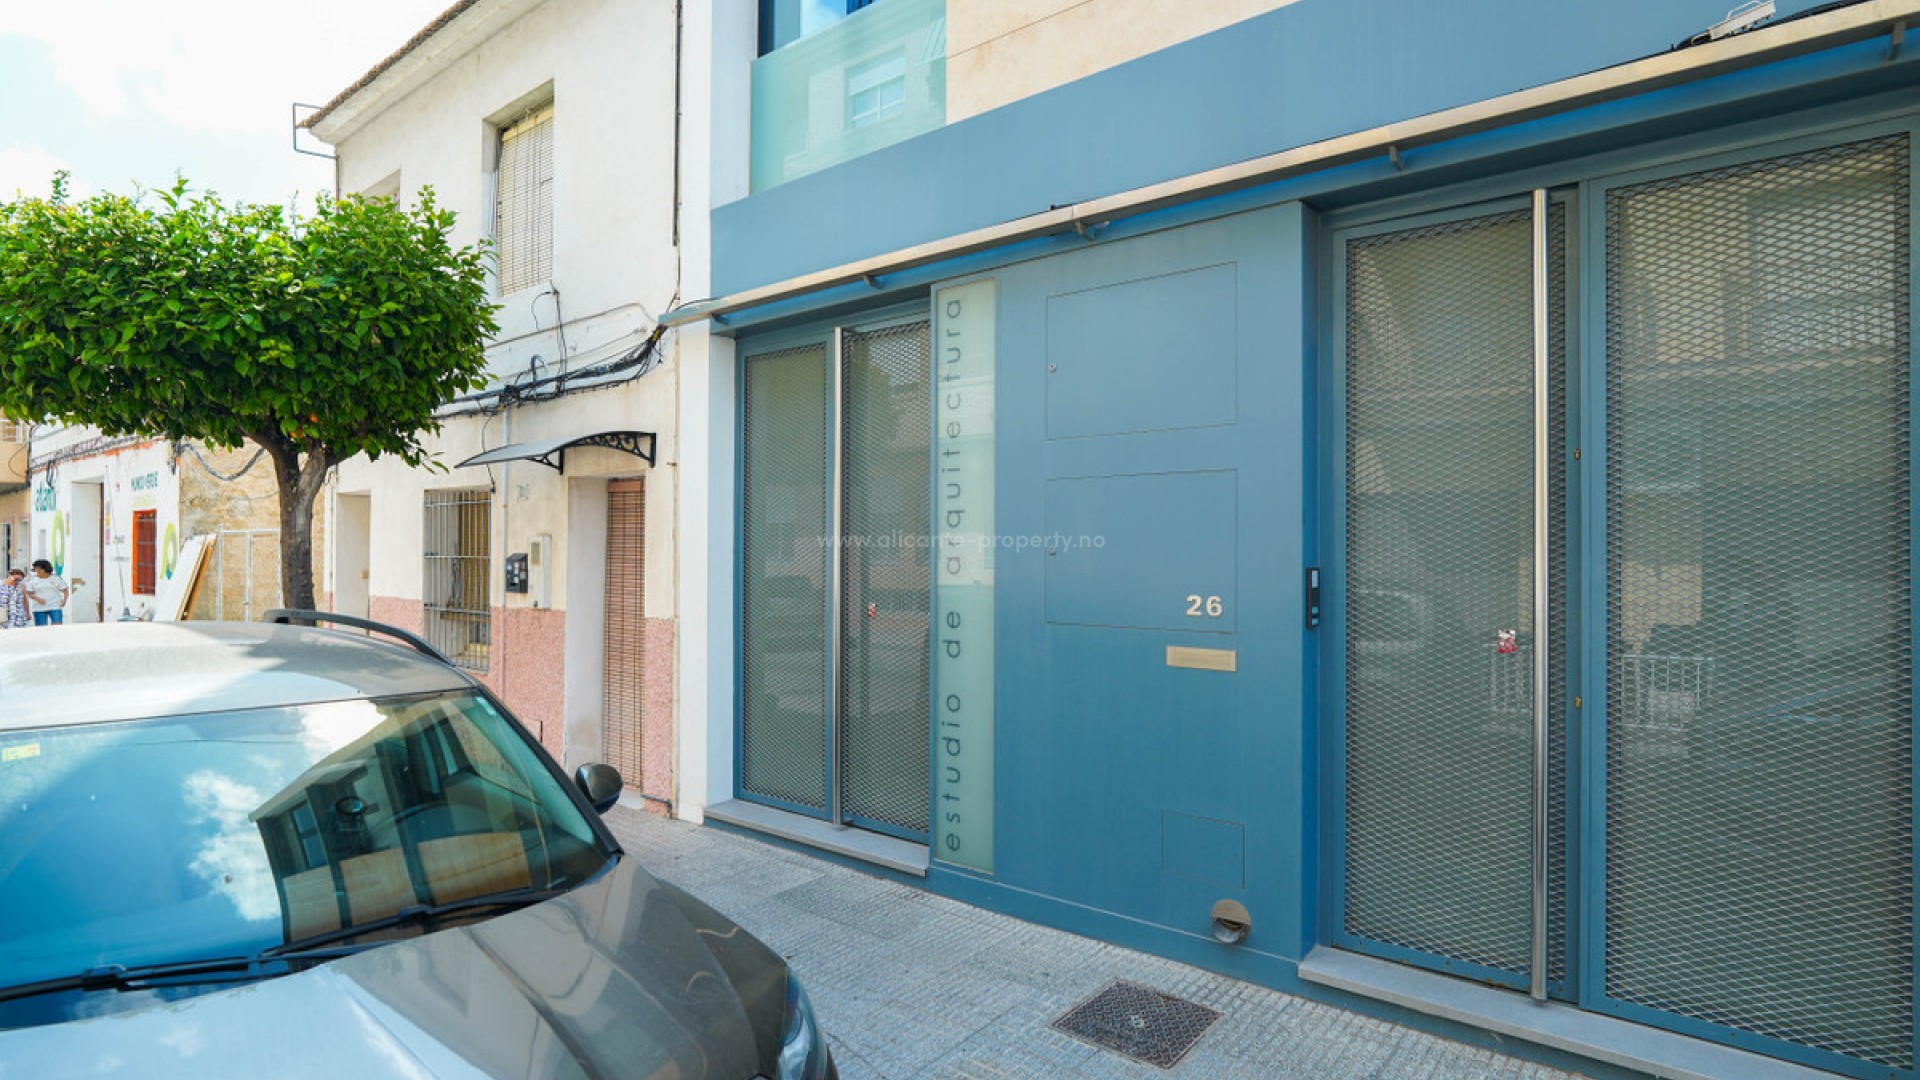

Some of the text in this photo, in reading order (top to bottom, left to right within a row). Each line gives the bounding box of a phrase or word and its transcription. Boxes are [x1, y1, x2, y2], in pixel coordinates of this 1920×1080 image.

[942, 299, 965, 851] estudio de arquitectura
[1186, 594, 1223, 617] 26
